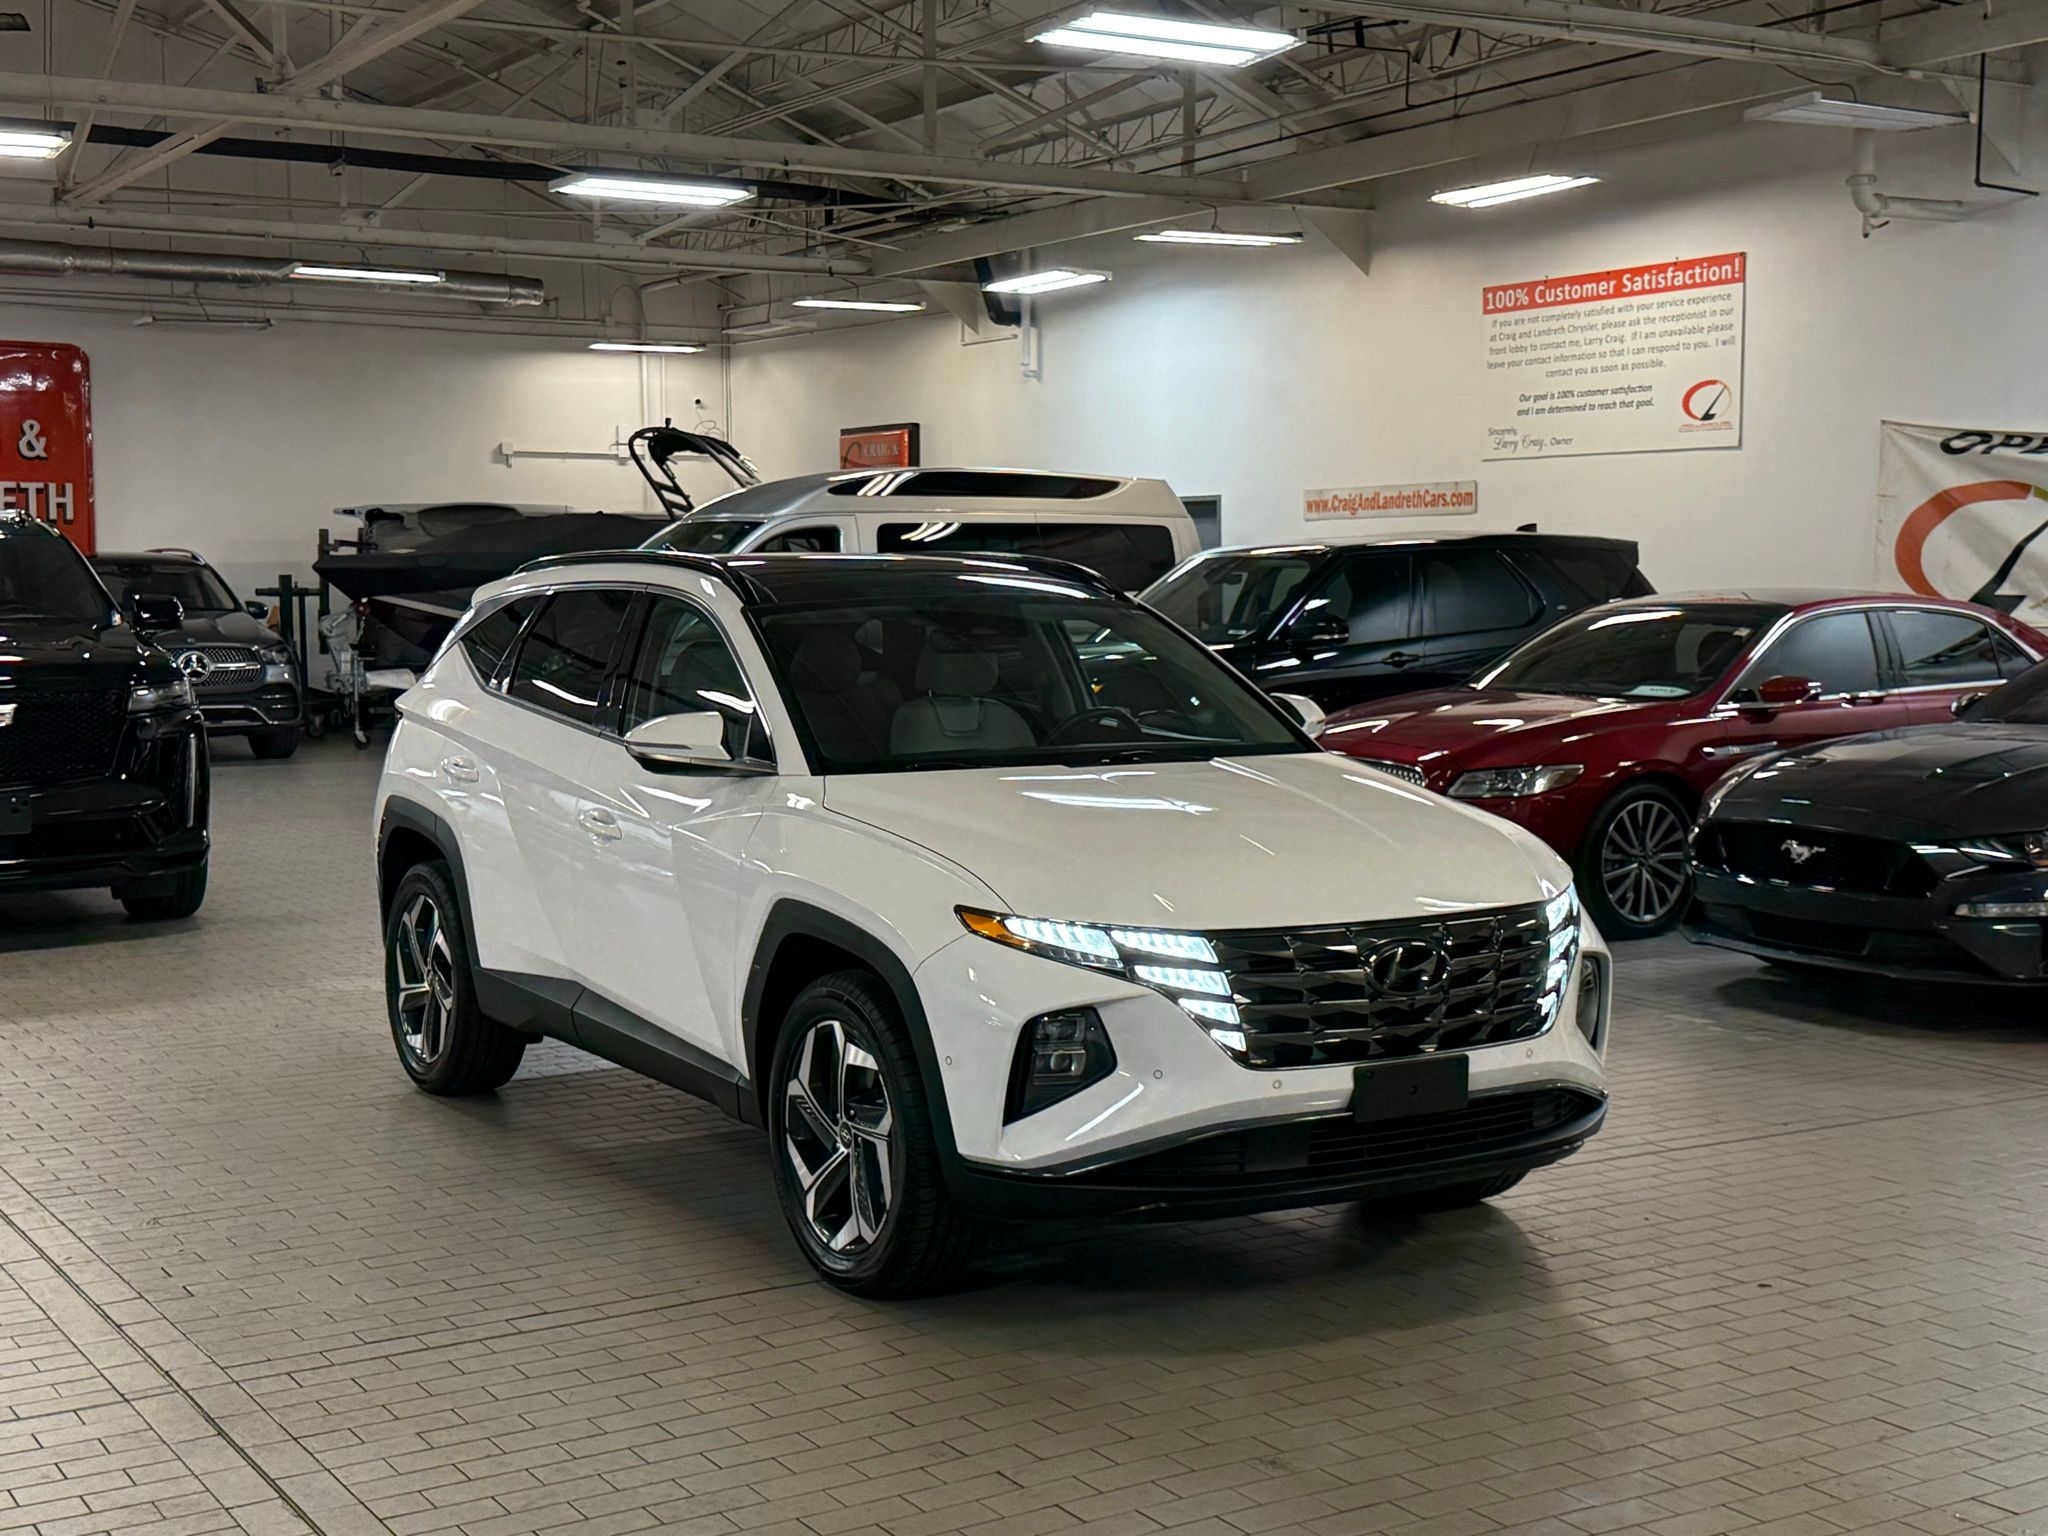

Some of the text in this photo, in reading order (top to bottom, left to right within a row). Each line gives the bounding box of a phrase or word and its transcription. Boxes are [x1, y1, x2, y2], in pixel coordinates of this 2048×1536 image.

[1486, 257, 1739, 310] 100% Customer Satisfaction!
[1489, 333, 1497, 342] at
[1498, 331, 1517, 342] Craig
[1518, 330, 1532, 339] and
[1533, 326, 1566, 338] Landreth
[1601, 317, 1626, 331] please
[1627, 316, 1641, 326] ask
[1643, 315, 1657, 325] the
[1658, 310, 1707, 323] receptionist
[1709, 308, 1717, 317] in
[1719, 307, 1734, 316] our
[1492, 292, 1732, 330] If you are not completely satisfied with your service experience
[1487, 360, 1506, 370] leave
[1507, 360, 1523, 369] your
[1525, 356, 1552, 366] contact
[1553, 352, 1597, 363] information
[1598, 350, 1607, 359] so
[1609, 347, 1625, 357] that
[1632, 346, 1646, 355] can
[1647, 343, 1680, 354] respond
[1682, 341, 1691, 350] to
[1721, 336, 1735, 346] will
[1489, 347, 1507, 356] front
[1508, 345, 1529, 355] lobby
[1530, 343, 1538, 352] to
[1539, 340, 1567, 351] contact
[1583, 337, 1604, 347] Larry
[1631, 331, 1637, 340] If
[1644, 331, 1657, 340] am
[1658, 325, 1705, 338] unavailable
[1706, 322, 1734, 335] please
[1545, 359, 1666, 378] contact you as soon as possible.
[1516, 407, 1530, 416] and
[1535, 407, 1546, 415] am
[1547, 403, 1588, 414] determined
[1588, 402, 1596, 411] to
[1597, 401, 1617, 410] reach
[1619, 399, 1634, 409] that
[1519, 383, 1652, 403] Our goal is 100% customer satisfaction
[18, 419, 48, 459] &
[1550, 437, 1573, 447] Owner
[1306, 489, 1472, 515] www.CraigAndLandrethCars.com
